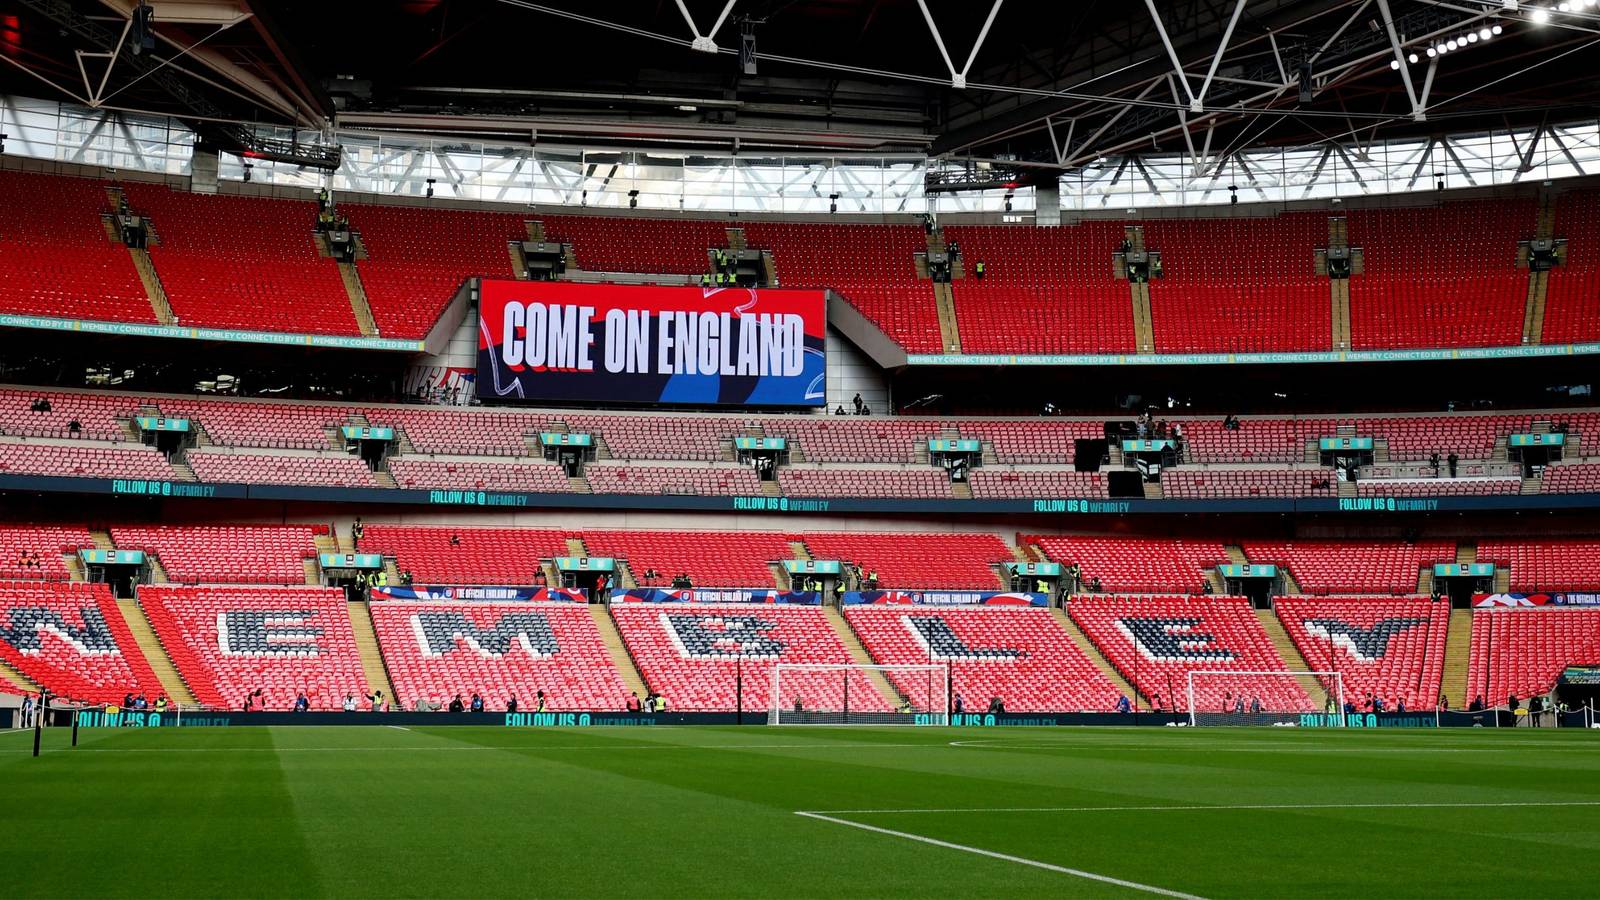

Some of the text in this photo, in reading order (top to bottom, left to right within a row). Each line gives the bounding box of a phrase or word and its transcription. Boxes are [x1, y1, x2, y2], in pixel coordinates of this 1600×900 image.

[0, 316, 51, 327] CONNECTED
[82, 322, 118, 332] WEMBLEY
[119, 324, 167, 336] CONNECTED
[199, 330, 235, 340] WEMBLEY
[236, 332, 284, 342] CONNECTED
[503, 301, 804, 377] COME ON ENGLAND
[313, 337, 348, 346] WEMBLEY
[350, 339, 397, 348] CONNECTED
[1272, 354, 1318, 362] CONNECTED
[1346, 352, 1382, 360] WEMBLEY
[1497, 348, 1543, 356] CONNECTED
[1017, 356, 1052, 364] WEMBLEY
[1054, 356, 1098, 364] CONNECTED
[1126, 356, 1161, 364] WEMBLEY
[112, 480, 147, 494] FOLLOW
[149, 481, 160, 494] US
[162, 482, 170, 495] @
[430, 491, 462, 503] FOLLOW
[464, 492, 475, 504] US
[478, 492, 486, 504] @
[734, 498, 766, 509] FOLLOW
[768, 498, 778, 509] US
[780, 498, 788, 510] @
[1034, 500, 1066, 512] FOLLOW
[1068, 500, 1078, 511] US
[1080, 500, 1088, 512] @
[1339, 498, 1372, 510] FOLLOW
[1374, 498, 1385, 510] US
[1387, 498, 1395, 510] @
[456, 589, 517, 599] THE OFFICIAL ENGLAND APP
[702, 591, 720, 602] OFFICIAL
[722, 591, 742, 602] ENGLAND
[743, 591, 752, 602] APP
[932, 594, 950, 603] OFFICIAL
[952, 594, 971, 603] ENGLAND
[972, 594, 981, 603] APP
[1567, 594, 1575, 604] THE
[1576, 594, 1596, 604] OFFICIAL
[148, 713, 160, 727] @
[506, 713, 555, 726] FOLLOW
[579, 714, 590, 726] @
[985, 714, 996, 726] @
[1366, 714, 1377, 727] @
